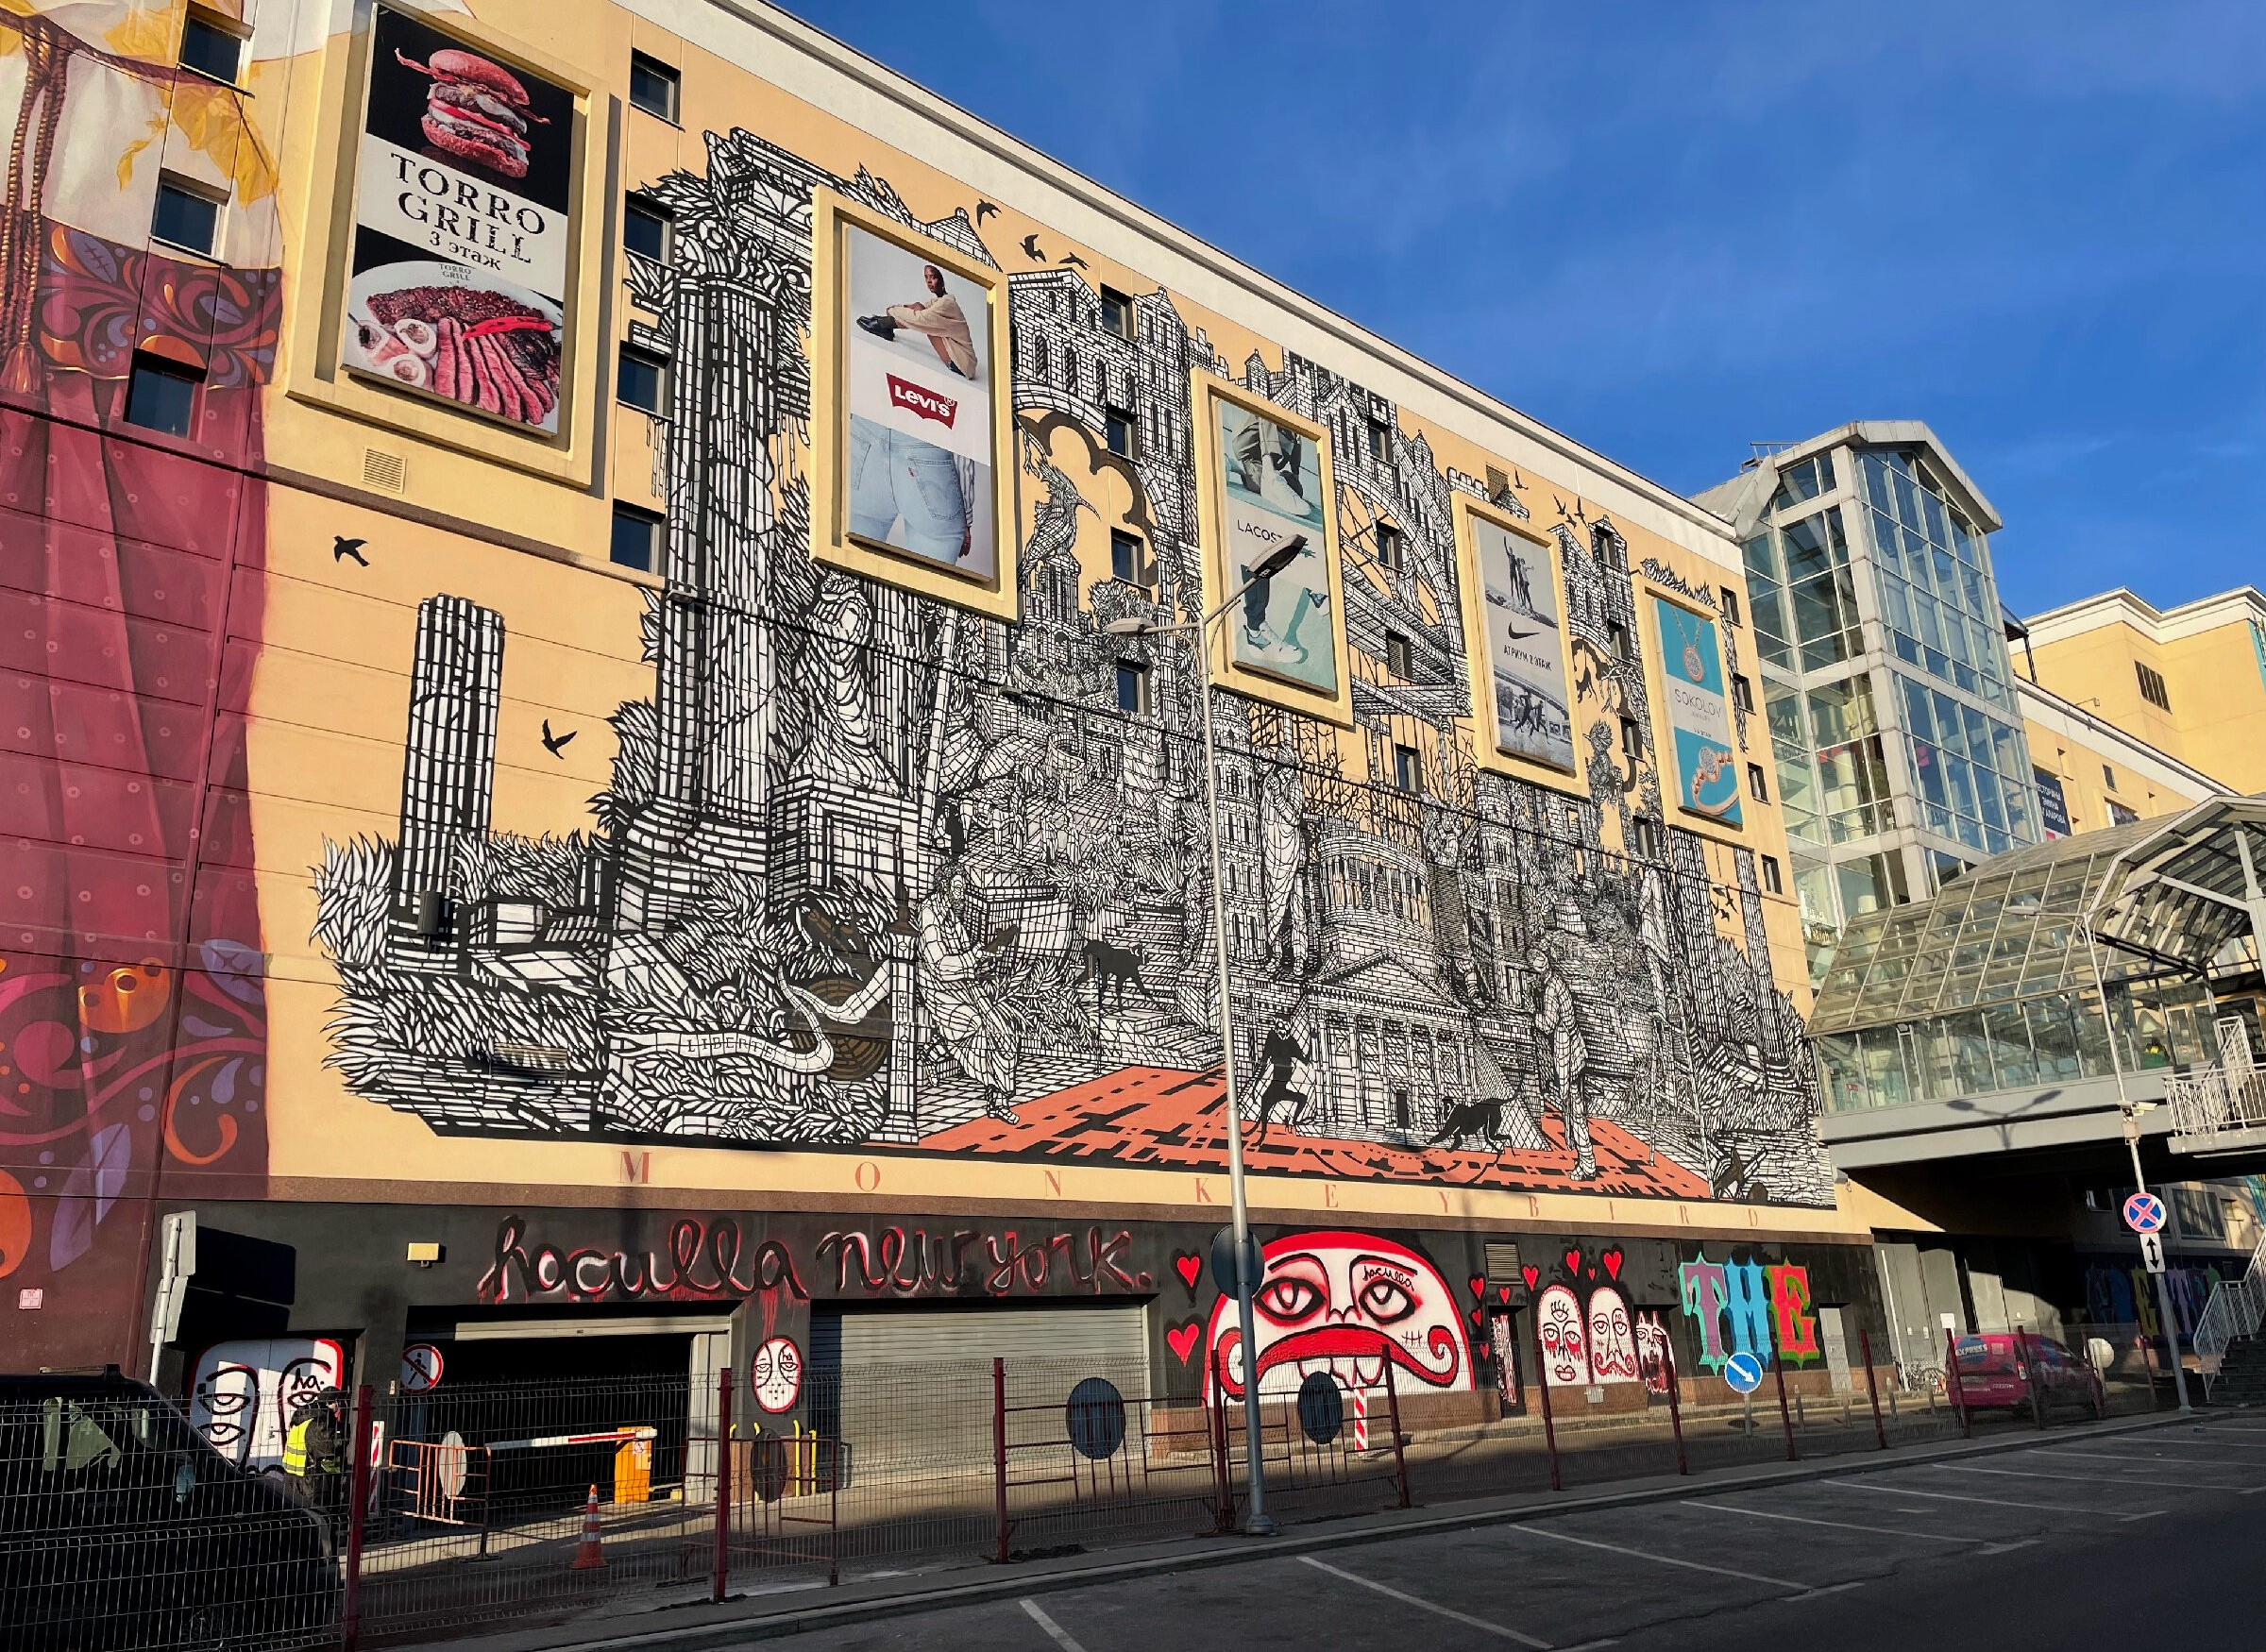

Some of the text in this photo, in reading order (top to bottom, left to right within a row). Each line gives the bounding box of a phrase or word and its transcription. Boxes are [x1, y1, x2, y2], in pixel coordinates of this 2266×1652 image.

[391, 152, 545, 235] TORRO
[398, 192, 532, 263] GRILL
[430, 230, 501, 271] 3 этаж
[438, 262, 472, 275] TORRO
[442, 270, 471, 281] GRILL
[1237, 518, 1283, 544] LACOS
[1674, 688, 1721, 718] SOKOLOV
[686, 1037, 774, 1058] LIBERTE
[1677, 1251, 1821, 1377] THE
